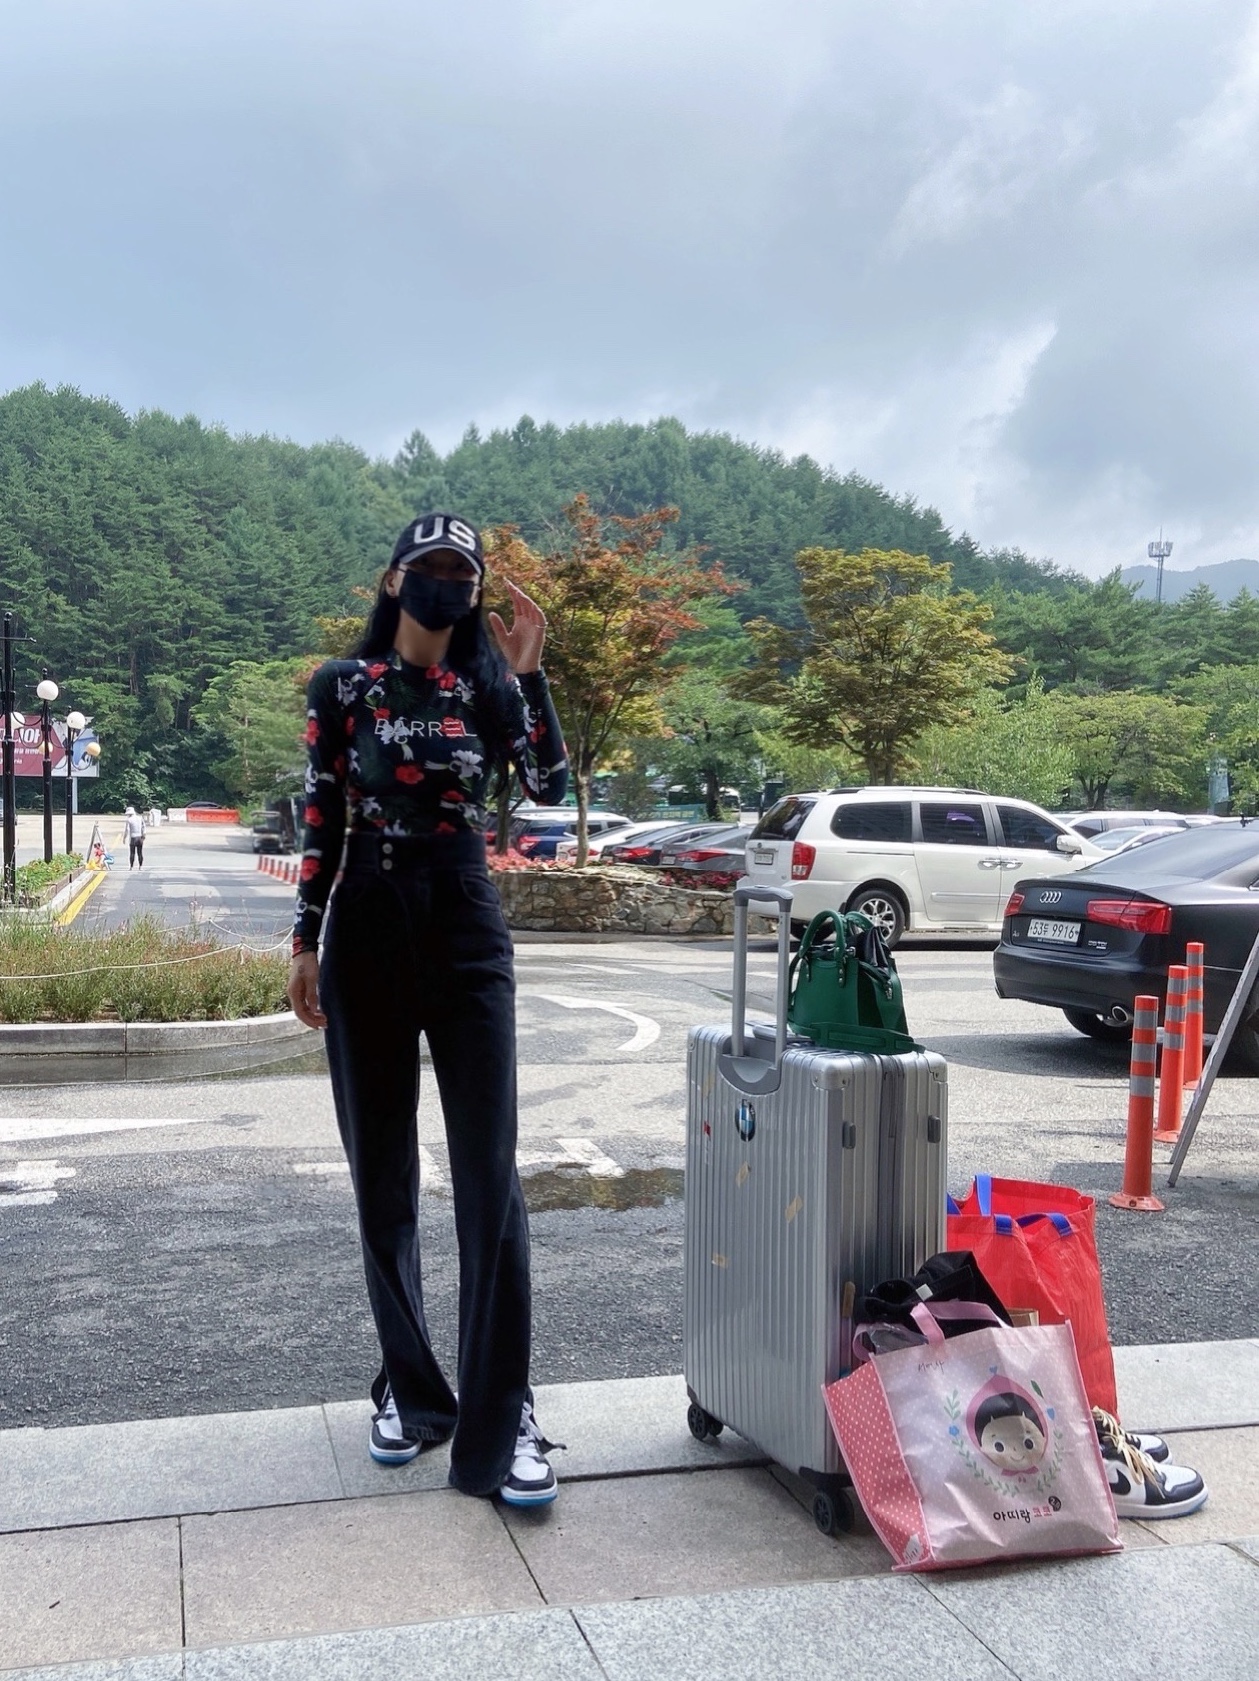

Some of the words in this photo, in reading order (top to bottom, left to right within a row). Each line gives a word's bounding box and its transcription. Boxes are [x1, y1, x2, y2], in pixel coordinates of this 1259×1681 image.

[413, 517, 476, 551] US
[1052, 923, 1074, 939] 9916
[993, 1508, 1031, 1524] 아띠랑
